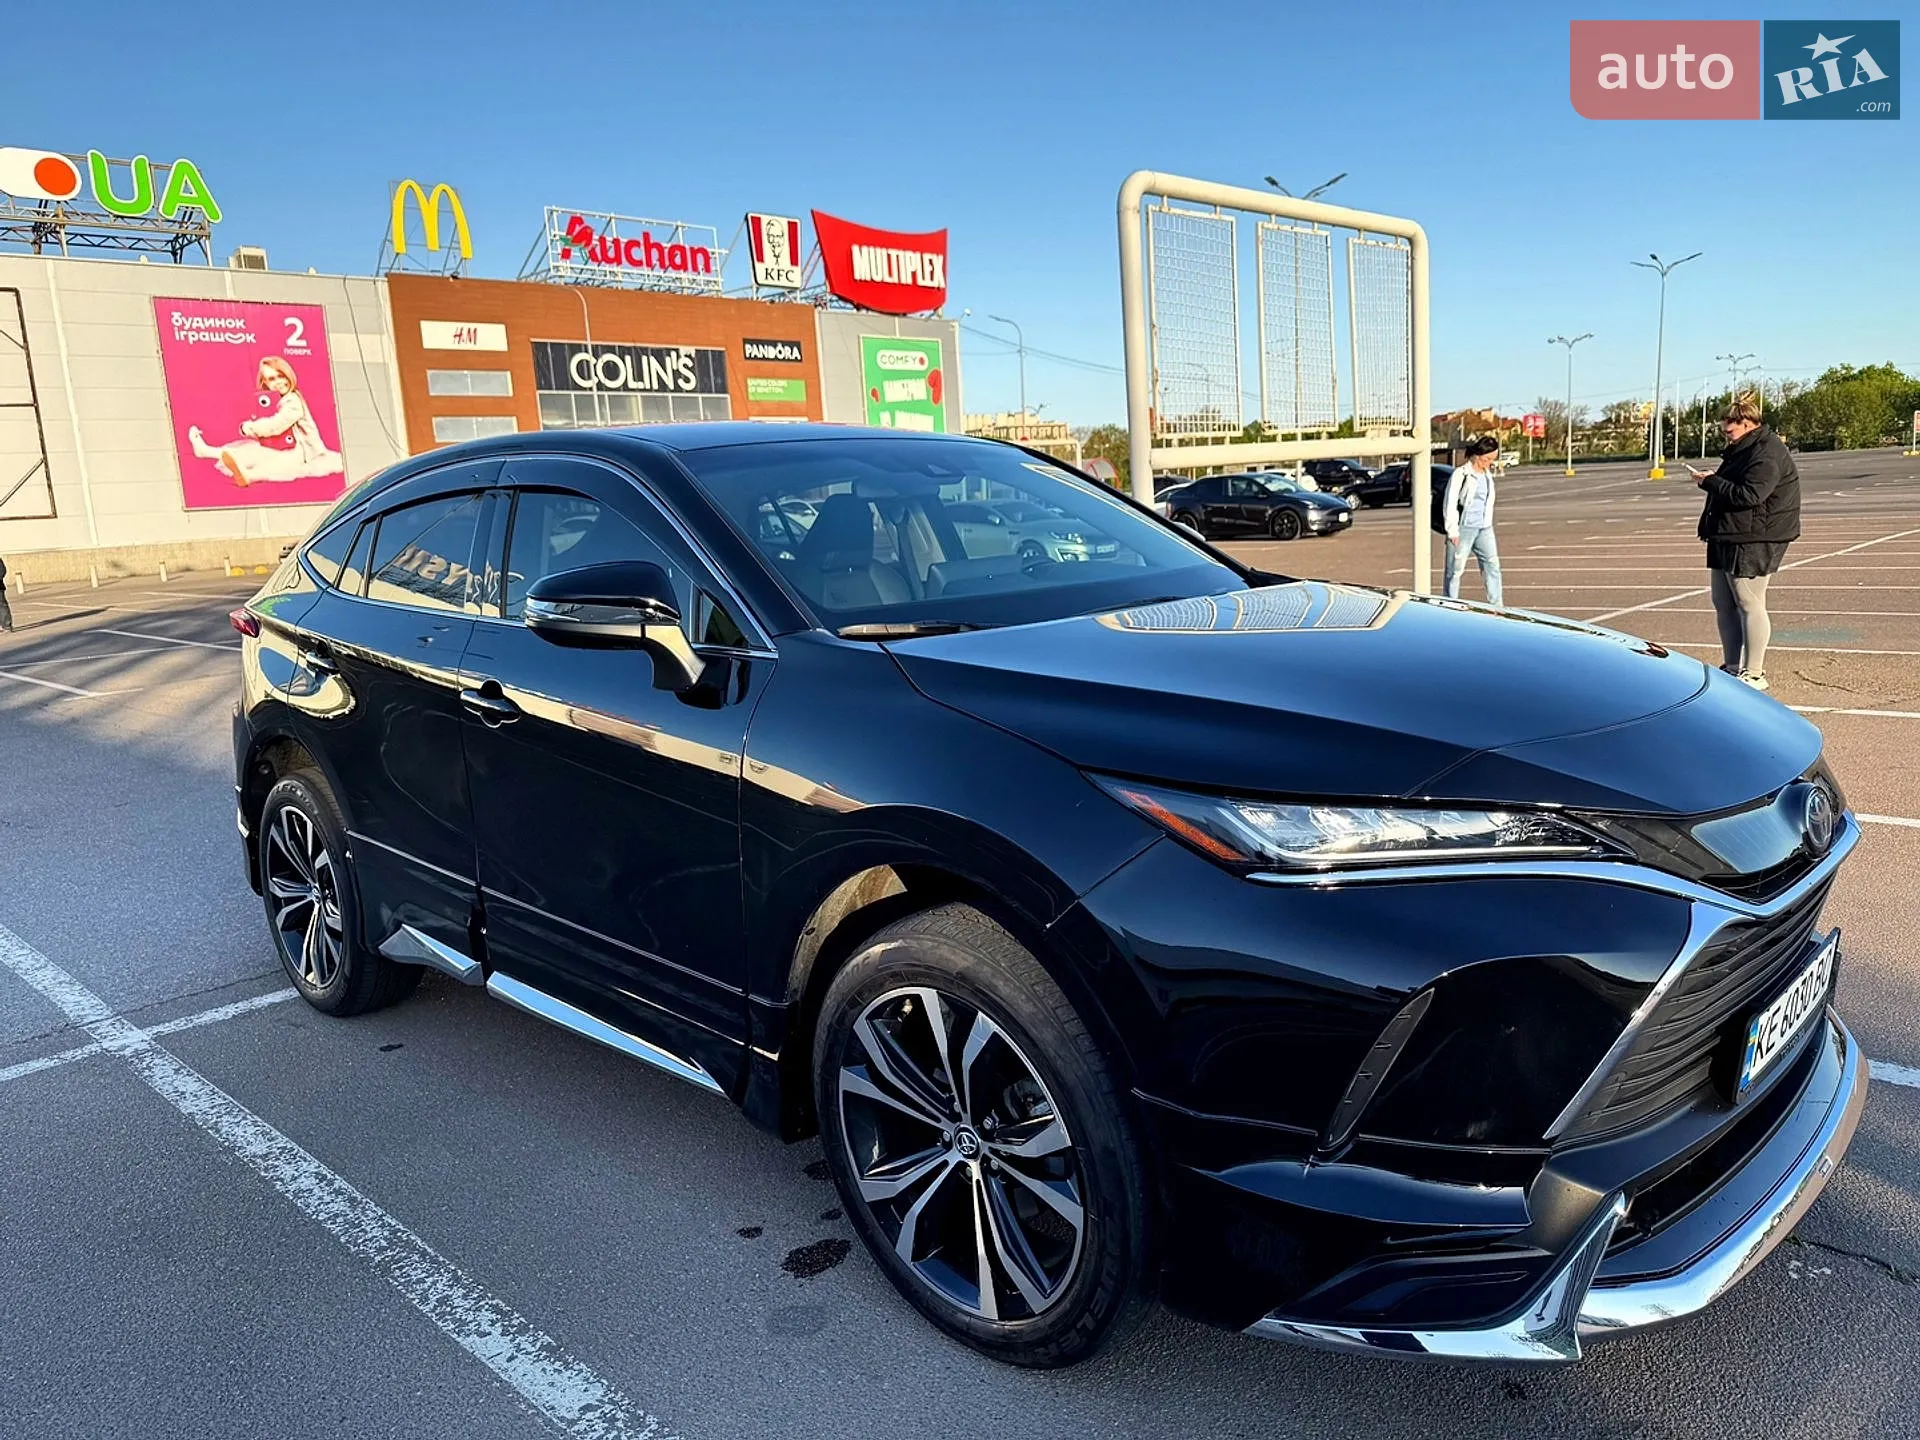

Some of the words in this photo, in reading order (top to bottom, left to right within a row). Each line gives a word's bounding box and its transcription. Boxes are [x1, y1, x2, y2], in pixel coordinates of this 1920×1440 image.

[87, 149, 223, 223] UA
[560, 215, 712, 274] Auchan
[764, 268, 795, 283] KFC
[851, 244, 946, 289] MULTIPLEX
[171, 312, 246, 329] будинок
[284, 317, 307, 347] 2
[744, 342, 802, 360] PANDORA
[880, 354, 917, 365] COMFY
[570, 350, 697, 391] COLIN'S
[1753, 1005, 1781, 1067] KE
[1780, 970, 1813, 1038] 6030
